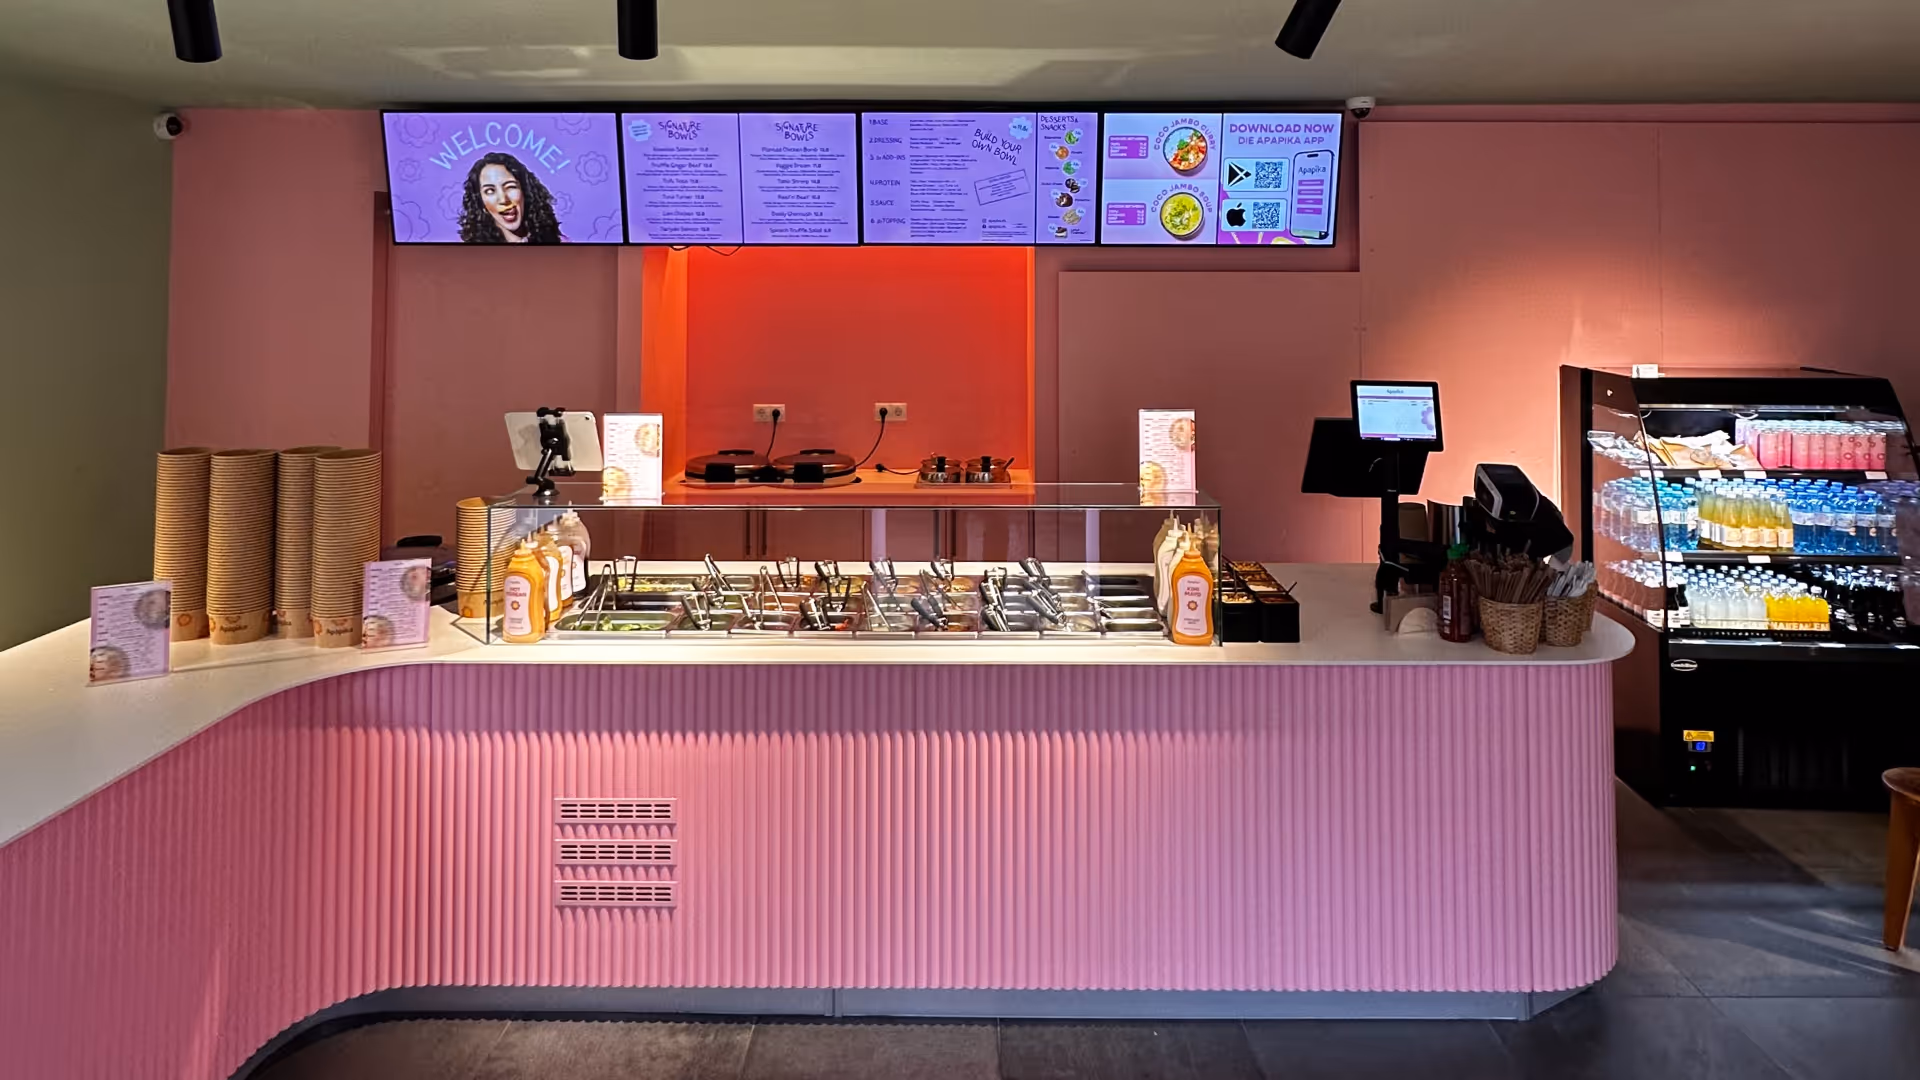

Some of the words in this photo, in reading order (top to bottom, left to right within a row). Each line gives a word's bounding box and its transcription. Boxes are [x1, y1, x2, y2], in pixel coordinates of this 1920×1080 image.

[1040, 115, 1074, 123] DESSERTS
[658, 120, 702, 133] SIGNATURE
[775, 121, 819, 134] SIGNATURE
[1040, 123, 1066, 131] SNACKS
[1229, 123, 1302, 133] DOWNLOAD
[1304, 123, 1334, 133] NOW
[668, 130, 698, 140] BOWLS
[784, 131, 814, 141] BOWLS
[974, 128, 998, 144] BUILD
[1000, 139, 1022, 154] YOUR
[1154, 126, 1169, 150] COCO
[1170, 118, 1200, 128] JAMBO
[1200, 124, 1217, 151] CURRY
[1238, 136, 1254, 145] DIE
[1256, 136, 1302, 145] APAPIKA
[1303, 136, 1325, 145] APP
[429, 121, 571, 174] WELCOME!
[971, 139, 993, 153] OWN
[993, 147, 1017, 166] BOWL
[1151, 189, 1168, 213] COCO
[1169, 183, 1199, 193] JAMBO
[1199, 191, 1213, 213] SOUP
